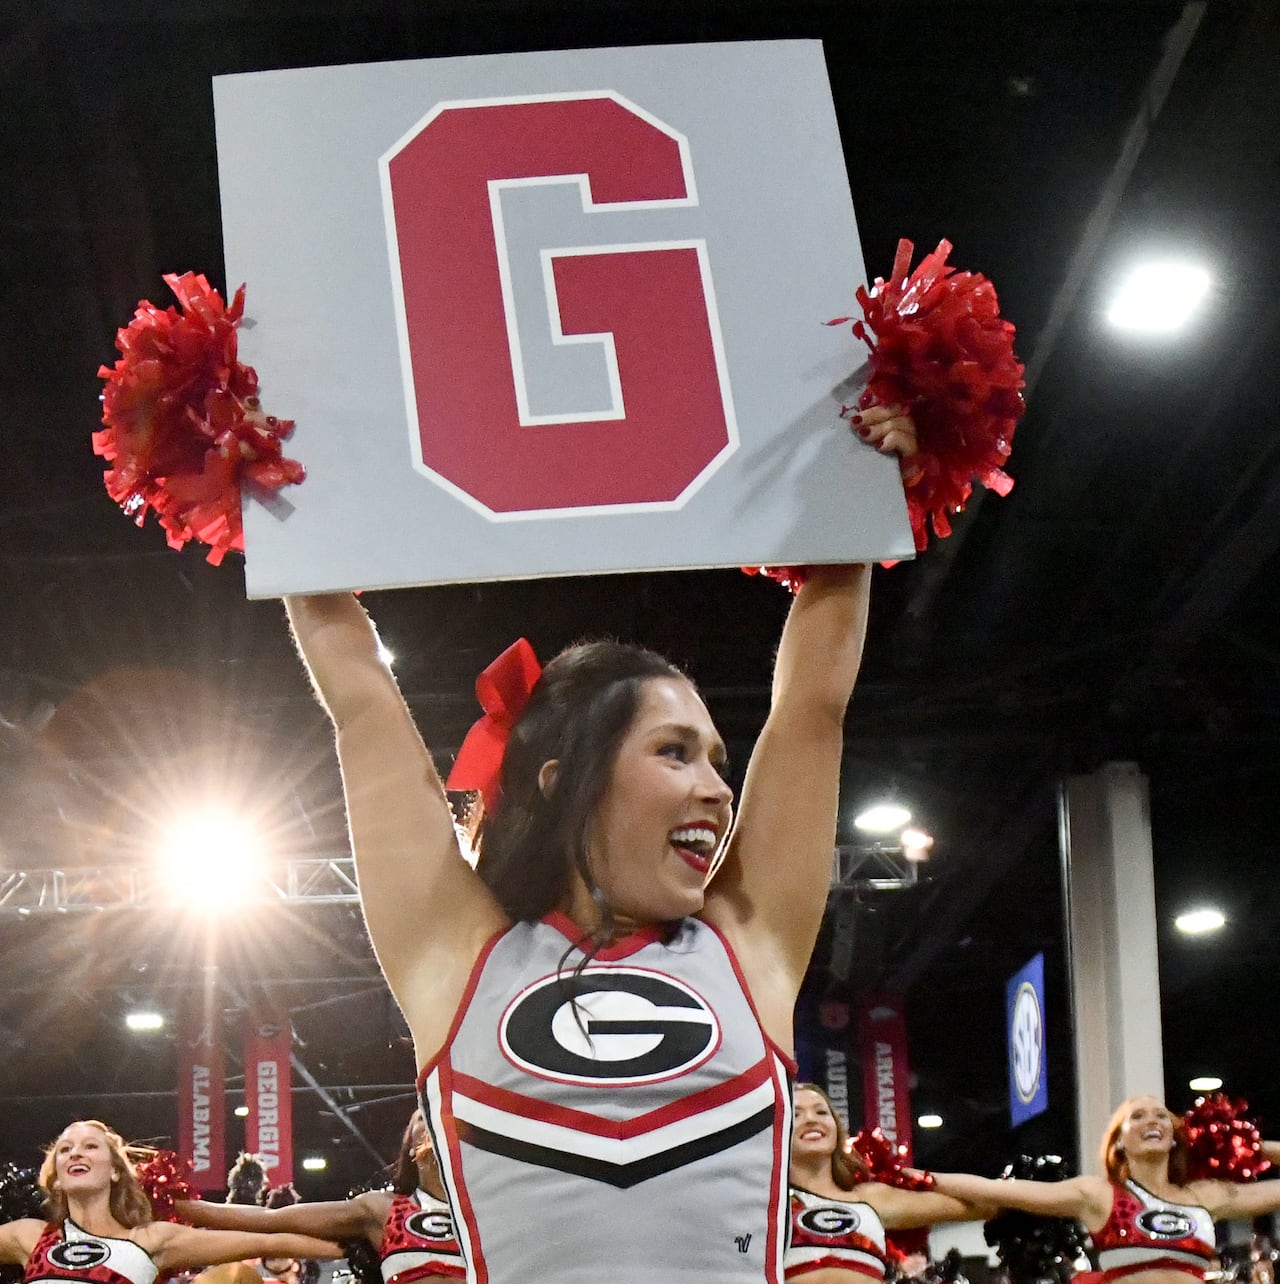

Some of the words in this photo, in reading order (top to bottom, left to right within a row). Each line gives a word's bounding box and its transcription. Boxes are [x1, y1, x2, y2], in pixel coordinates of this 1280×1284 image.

[379, 90, 740, 522] G
[501, 969, 718, 1083] G
[192, 1064, 211, 1172] ALABAMA
[256, 1061, 280, 1169] GEORGIA
[46, 1238, 111, 1270] G
[798, 1205, 861, 1238] G
[1134, 1207, 1197, 1240] G
